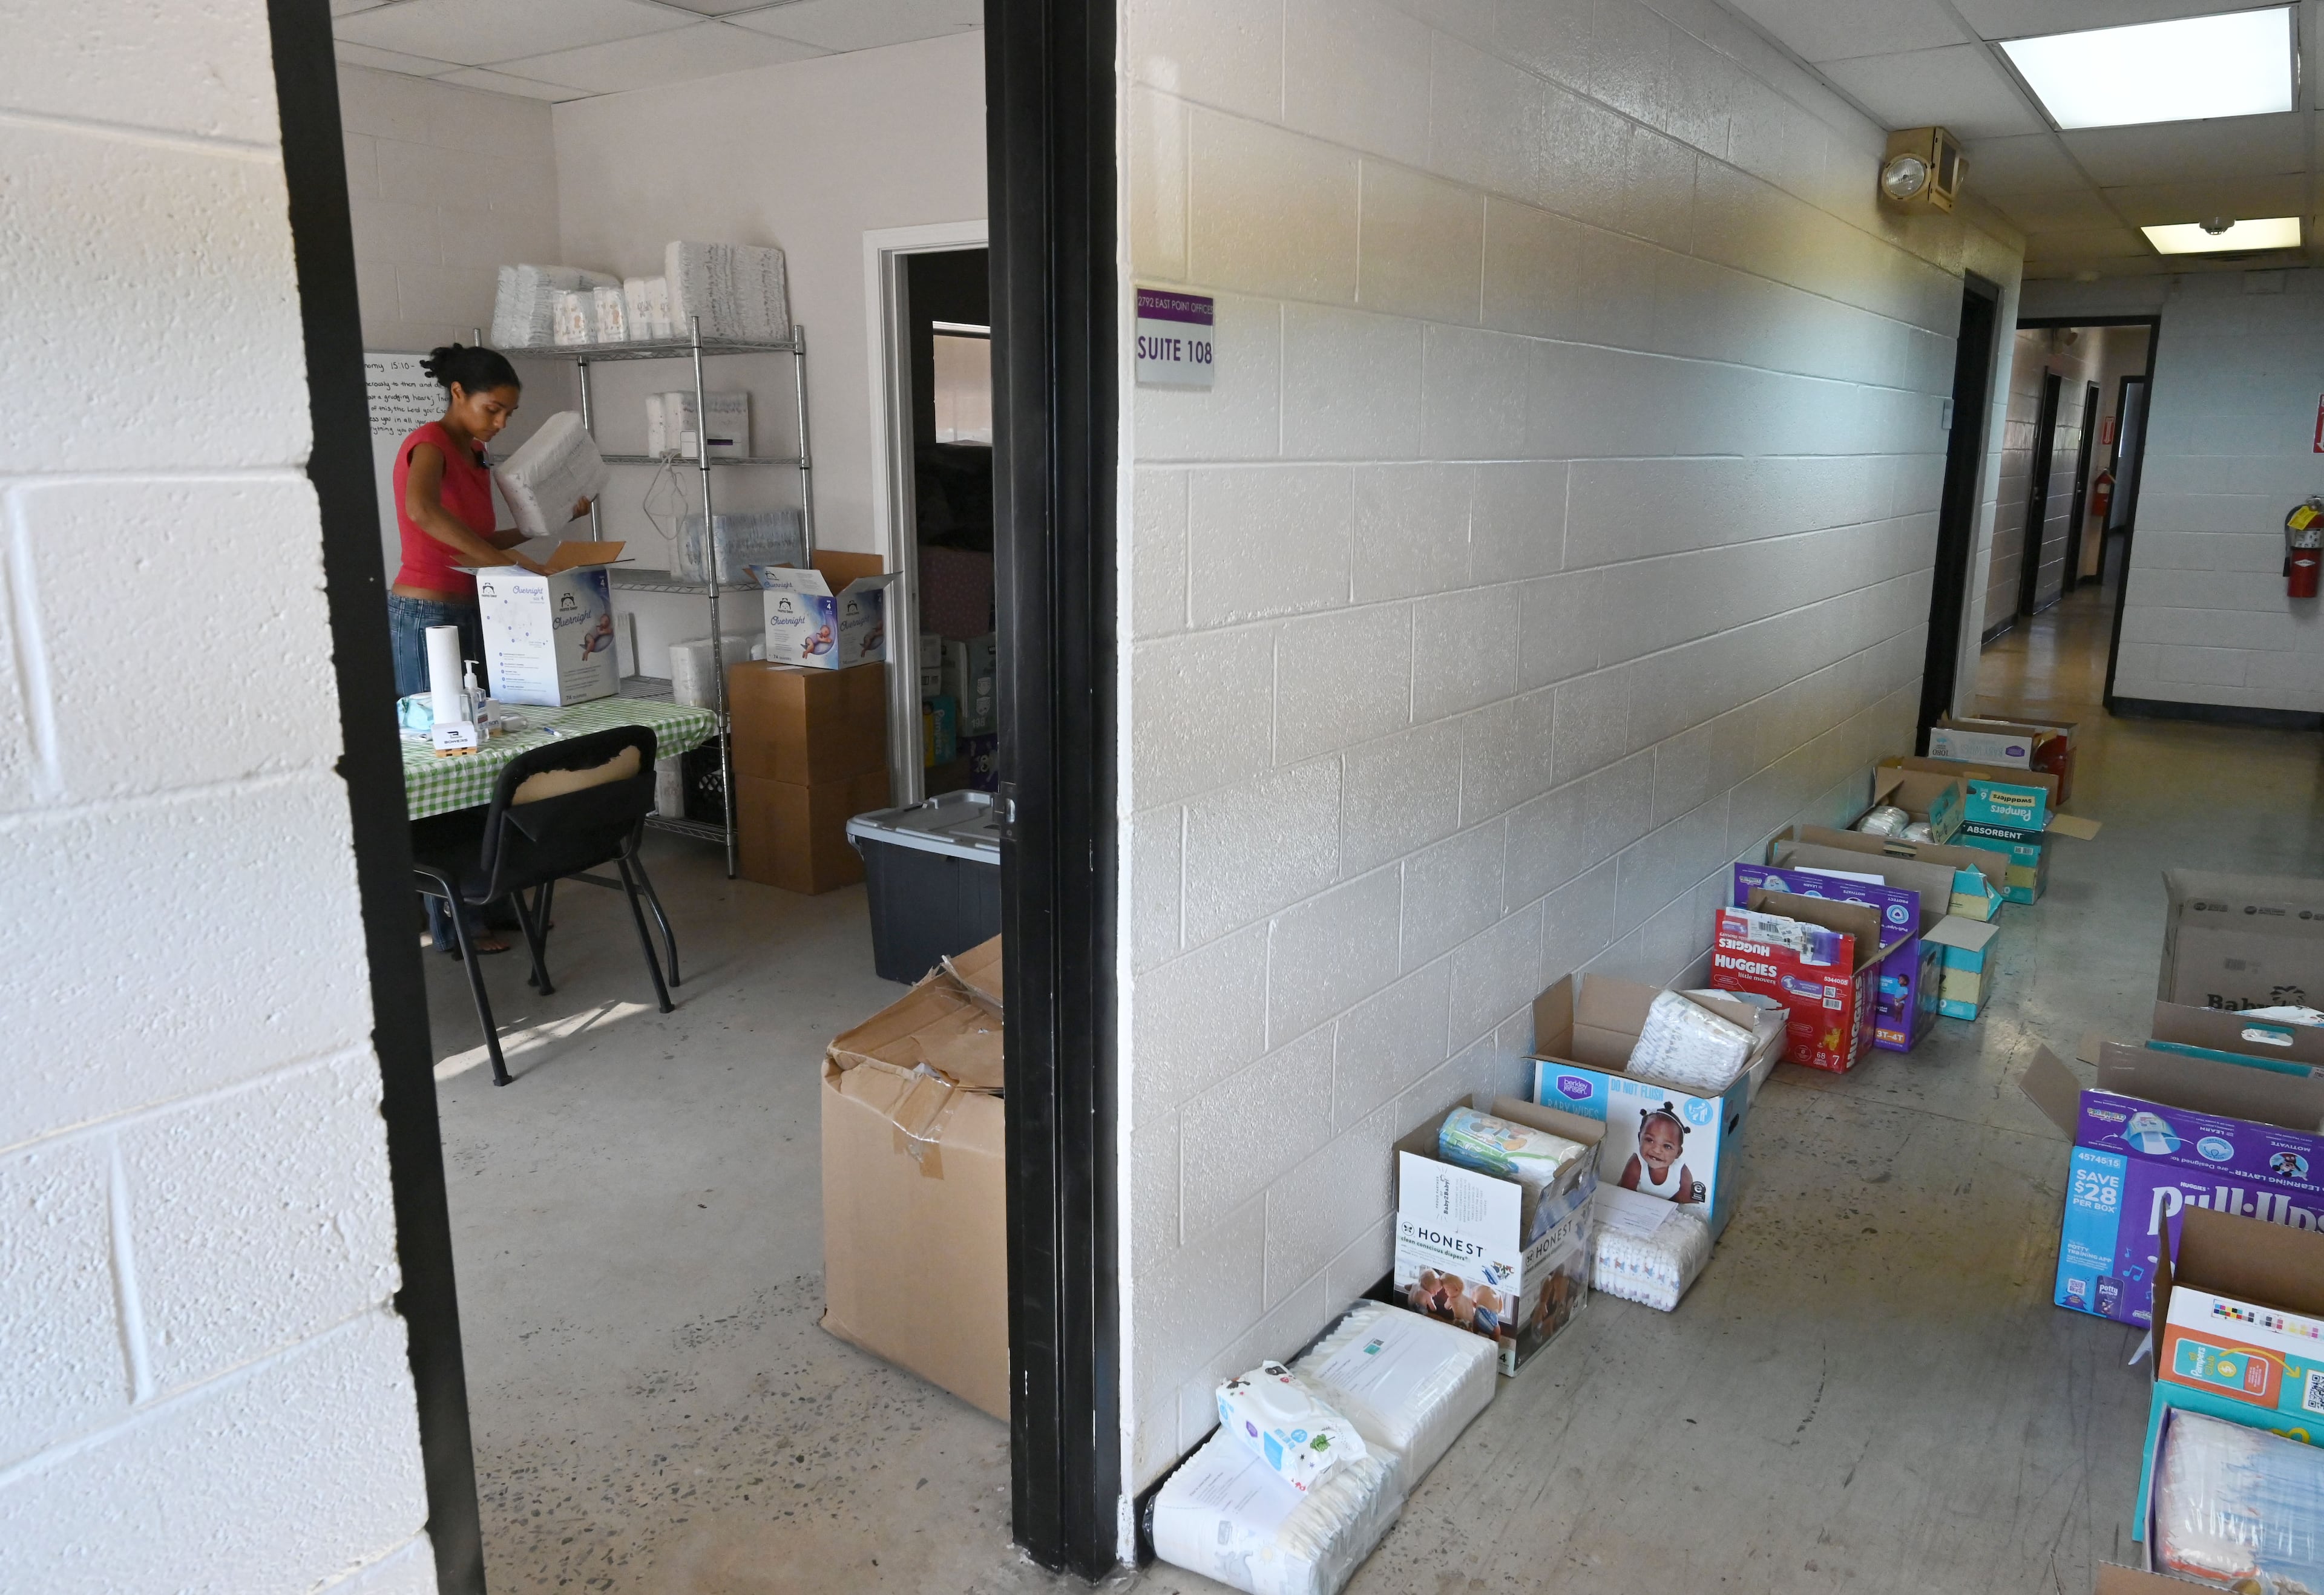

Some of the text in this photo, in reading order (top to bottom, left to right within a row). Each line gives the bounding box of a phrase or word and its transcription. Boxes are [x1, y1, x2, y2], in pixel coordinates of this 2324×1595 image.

[1138, 296, 1213, 315] 2792 EAST POINT OFFICES
[1138, 336, 1212, 364] SUITE 108
[513, 585, 543, 596] Overnight
[552, 610, 591, 630] Overnight
[770, 616, 806, 627] Overnight
[1993, 794, 2032, 804] swaddlers
[1990, 805, 2032, 822] Pampers
[1967, 825, 2023, 840] ABSORBENT
[1718, 938, 1770, 957] HUGGIES
[1715, 954, 1777, 978] HUGGIES
[1753, 975, 1776, 985] movers
[2207, 993, 2271, 1012] Bab
[1846, 975, 1863, 1069] HUGGIES
[1832, 1055, 1840, 1066] 7
[1563, 1086, 1586, 1095] jensen
[1564, 1079, 1588, 1092] berkley
[1610, 1079, 1664, 1102] DO NOT FLUSH
[2199, 1126, 2225, 1136] LEARN
[2270, 1141, 2311, 1152] MOTIVATE
[2181, 1158, 2215, 1170] Designed
[2076, 1168, 2119, 1188] SAVE
[2180, 1181, 2207, 1192] HUGGIES
[2074, 1181, 2117, 1205] $28
[2073, 1198, 2092, 1208] PER
[1400, 1236, 1416, 1245] clean
[1416, 1241, 1443, 1254] conscious
[1419, 1227, 1484, 1258] HONEST
[1535, 1219, 1572, 1259] HONEST
[2067, 1243, 2089, 1252] POTTY
[1499, 1353, 1506, 1363] 4
[2190, 1346, 2206, 1378] Pampers
[2204, 1355, 2216, 1376] Club
